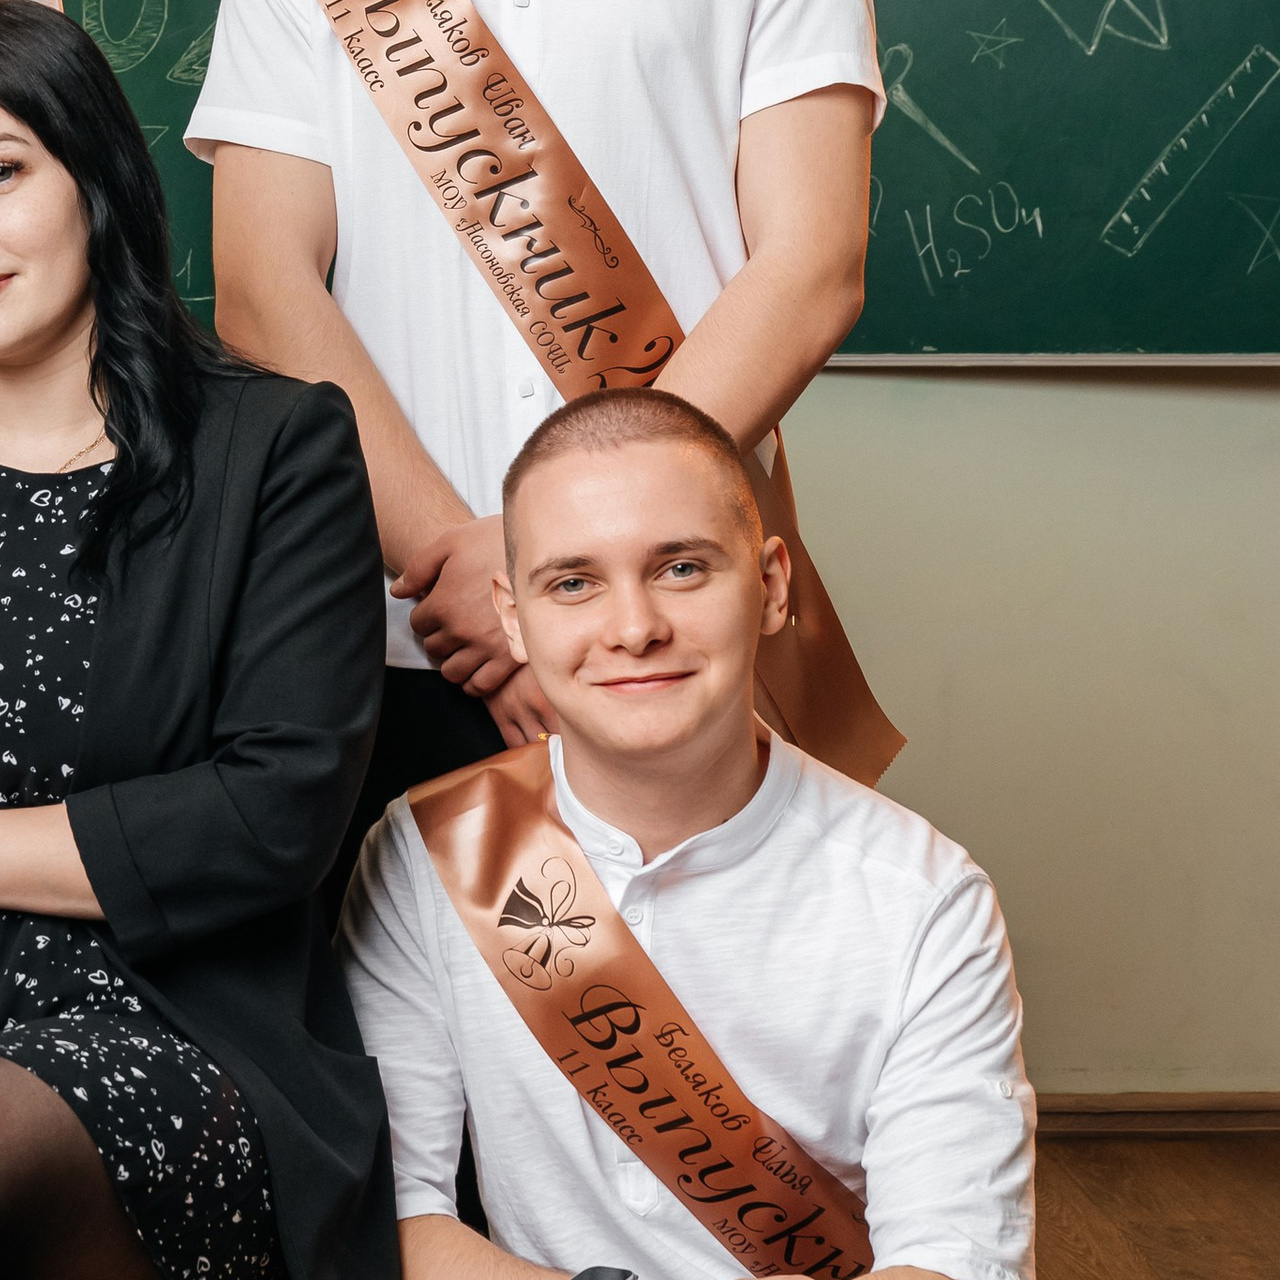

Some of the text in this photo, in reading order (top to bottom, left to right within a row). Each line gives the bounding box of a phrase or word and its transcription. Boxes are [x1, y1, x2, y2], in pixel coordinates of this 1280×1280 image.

[343, 29, 385, 94] класс
[482, 72, 537, 150] Иван
[430, 167, 468, 211] МОУ
[455, 216, 532, 319] «Насоновская
[556, 1047, 645, 1148] 11 класс
[652, 1021, 814, 1196] Беляков Илья
[711, 1217, 758, 1255] МОУ
